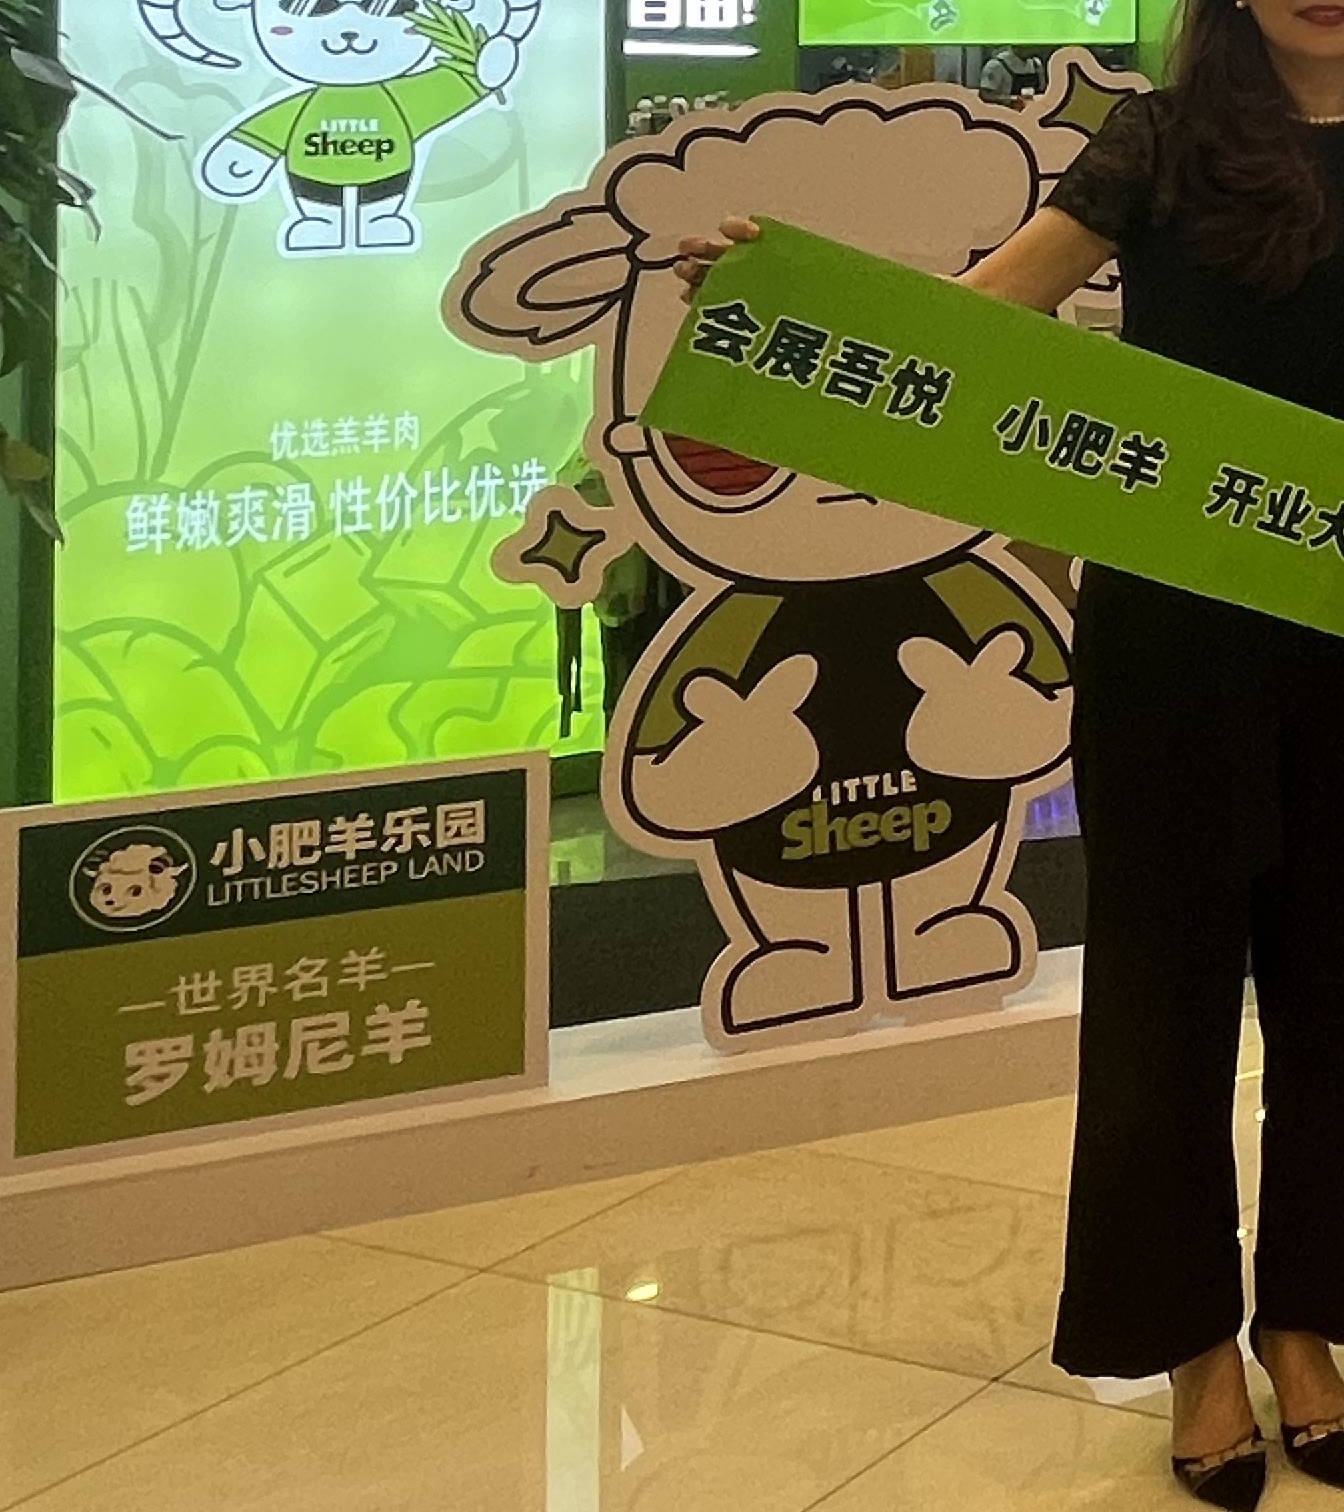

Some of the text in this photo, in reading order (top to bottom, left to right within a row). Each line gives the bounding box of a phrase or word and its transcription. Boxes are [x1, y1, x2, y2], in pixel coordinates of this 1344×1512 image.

[304, 131, 395, 163] Sheep
[320, 118, 379, 132] LITTLE
[689, 299, 956, 427] 会展吾悦
[994, 397, 1170, 494] 小肥羊
[268, 410, 421, 461] 优选羔羊肉
[125, 457, 549, 555] 鲜嫩爽滑 性价比优选
[812, 769, 918, 806] LITTLE
[208, 799, 488, 879] 小肥羊乐园
[781, 797, 953, 861] Sheep
[207, 849, 486, 907] LITTLESHEEP LAND
[171, 946, 390, 1016] 世界名羊
[124, 998, 432, 1107] 罗姆尼羊
